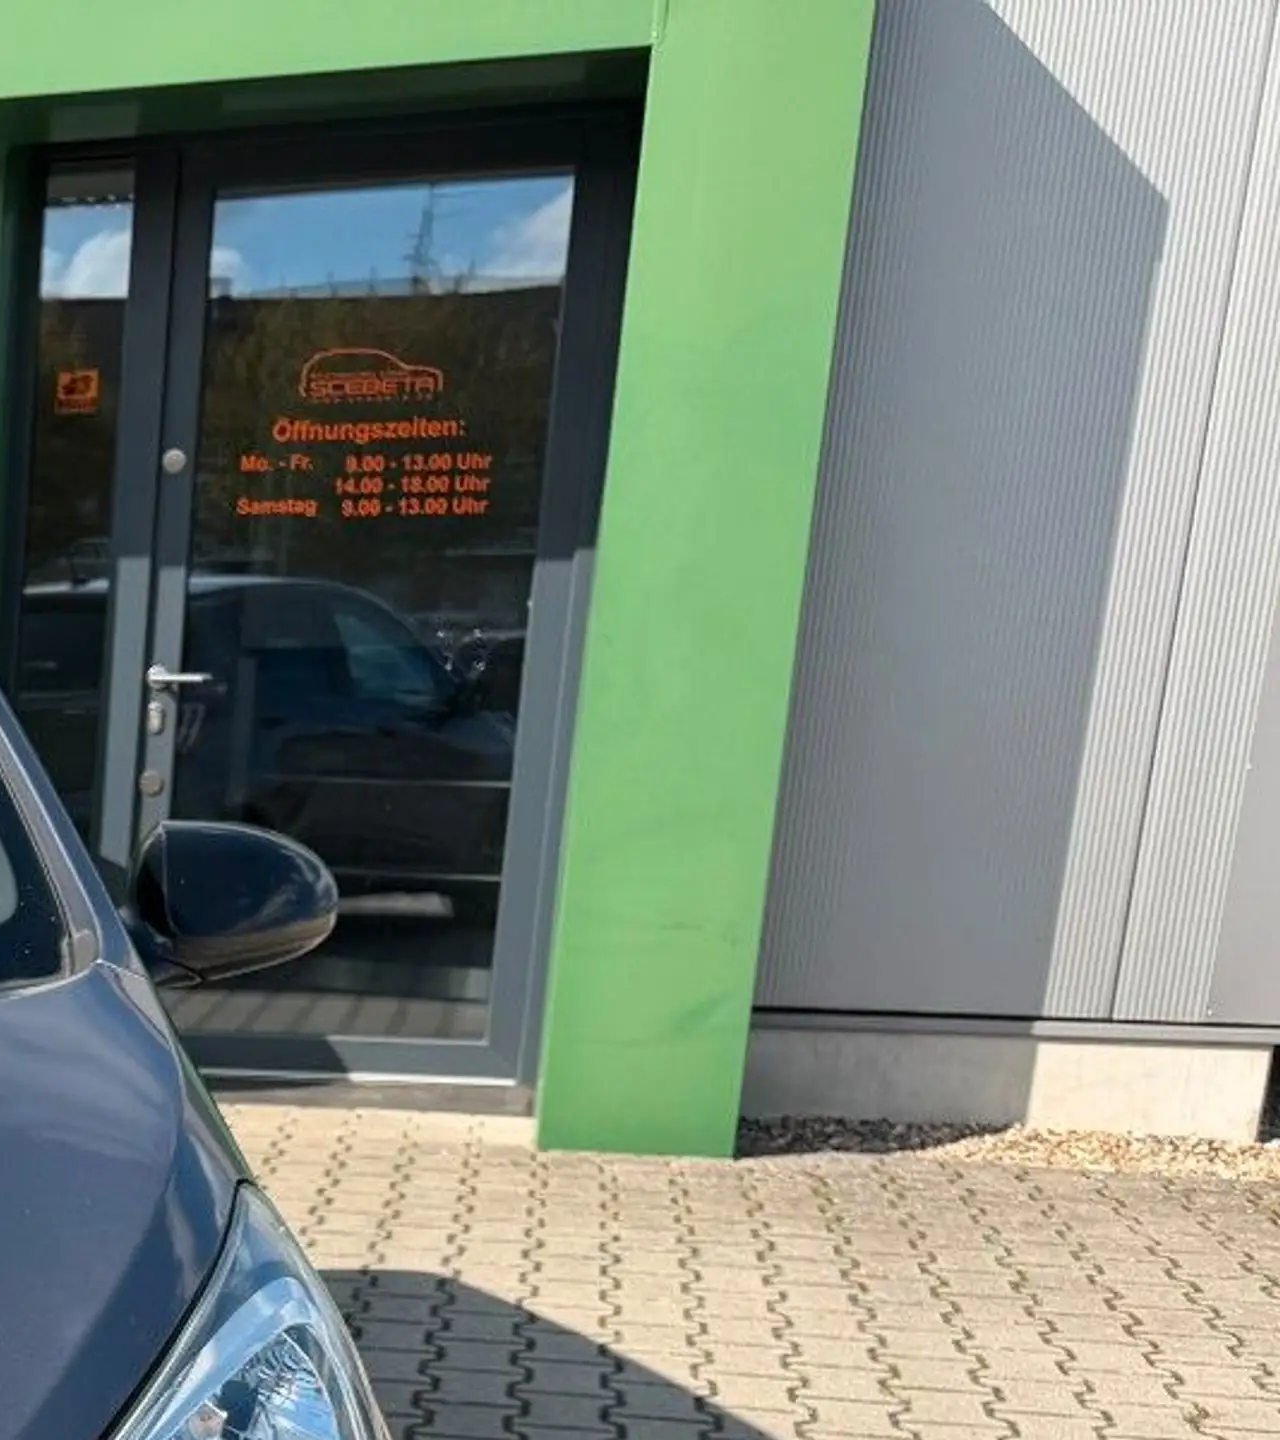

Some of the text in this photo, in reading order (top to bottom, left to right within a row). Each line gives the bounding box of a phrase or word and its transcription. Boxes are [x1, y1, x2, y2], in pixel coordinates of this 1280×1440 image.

[272, 416, 466, 444] Öffnungszeiten:
[240, 455, 274, 472] Mo.
[290, 454, 313, 471] Fr.
[403, 453, 453, 471] 13.00
[456, 452, 492, 470] Uhr
[335, 476, 384, 494] 14.00
[454, 473, 491, 492] Uhr
[236, 498, 318, 517] Samstag
[452, 496, 490, 515] Uhr
